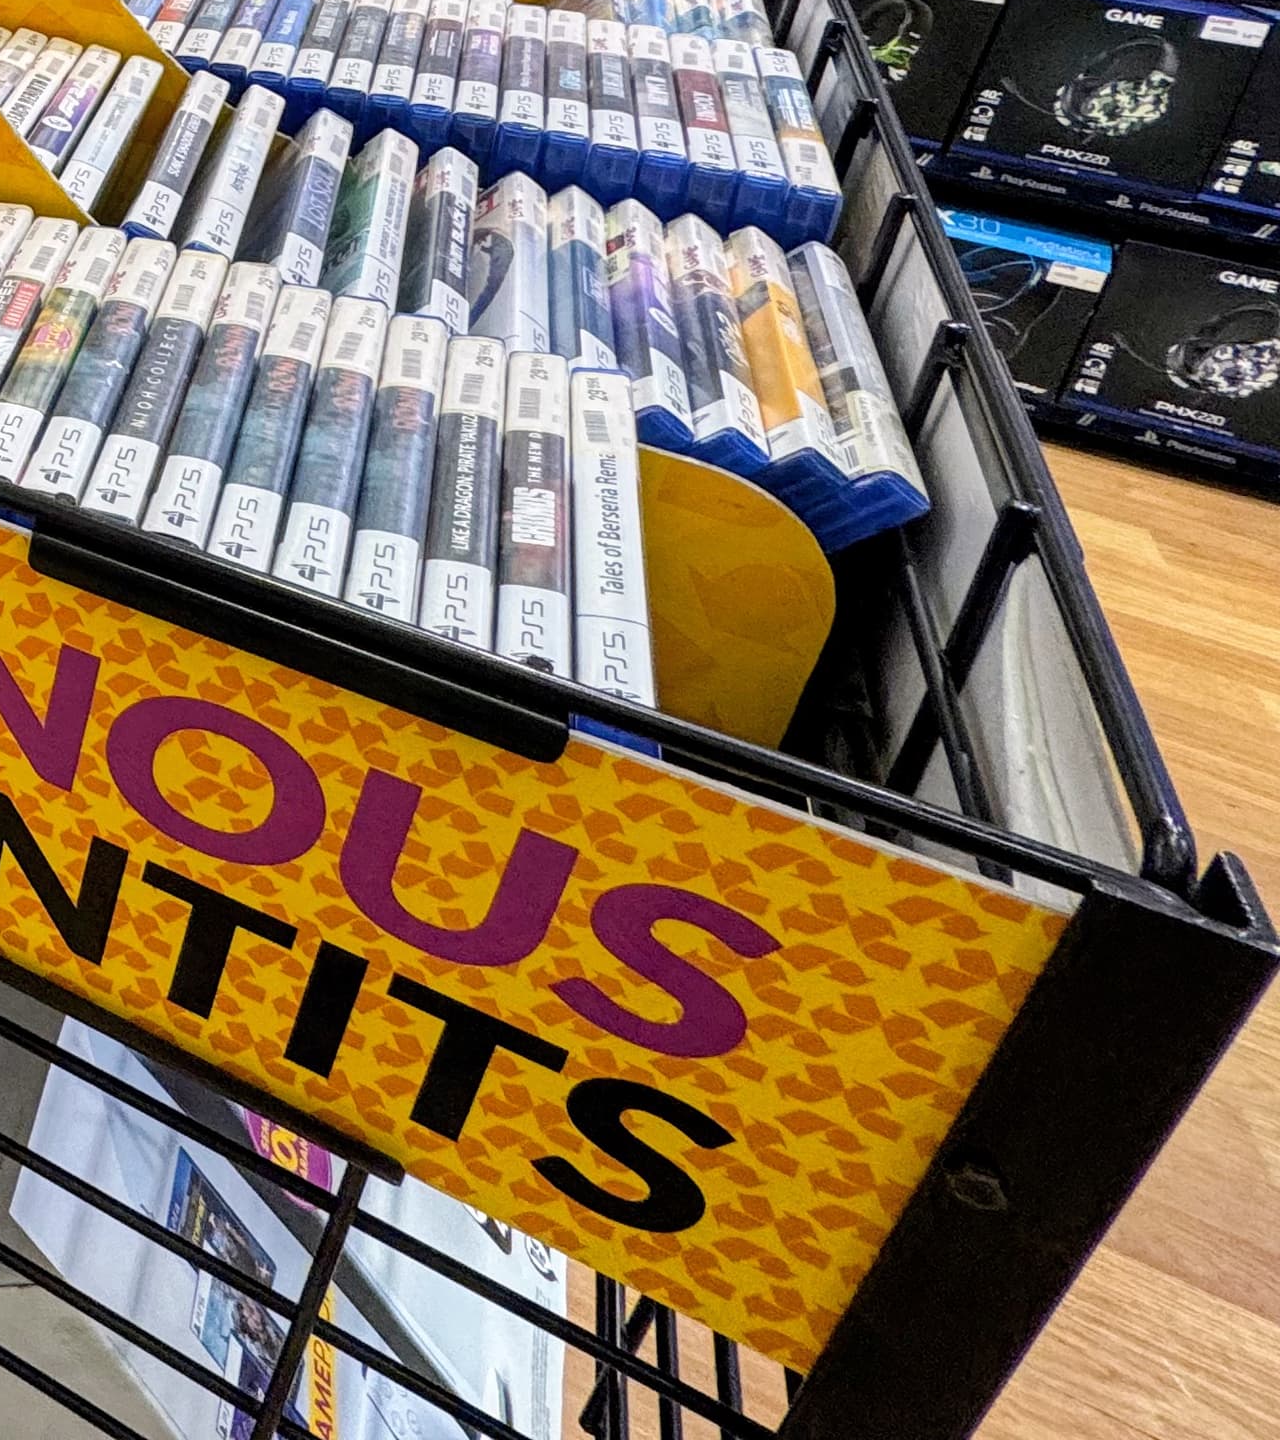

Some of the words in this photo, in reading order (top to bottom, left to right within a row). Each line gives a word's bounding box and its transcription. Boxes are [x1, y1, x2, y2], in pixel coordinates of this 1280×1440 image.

[1105, 9, 1165, 28] GAME
[529, 440, 542, 462] NEW
[528, 464, 542, 483] THE
[597, 485, 625, 540] Berseria
[603, 539, 622, 561] of
[601, 564, 625, 597] Tales
[605, 632, 626, 684] PS5
